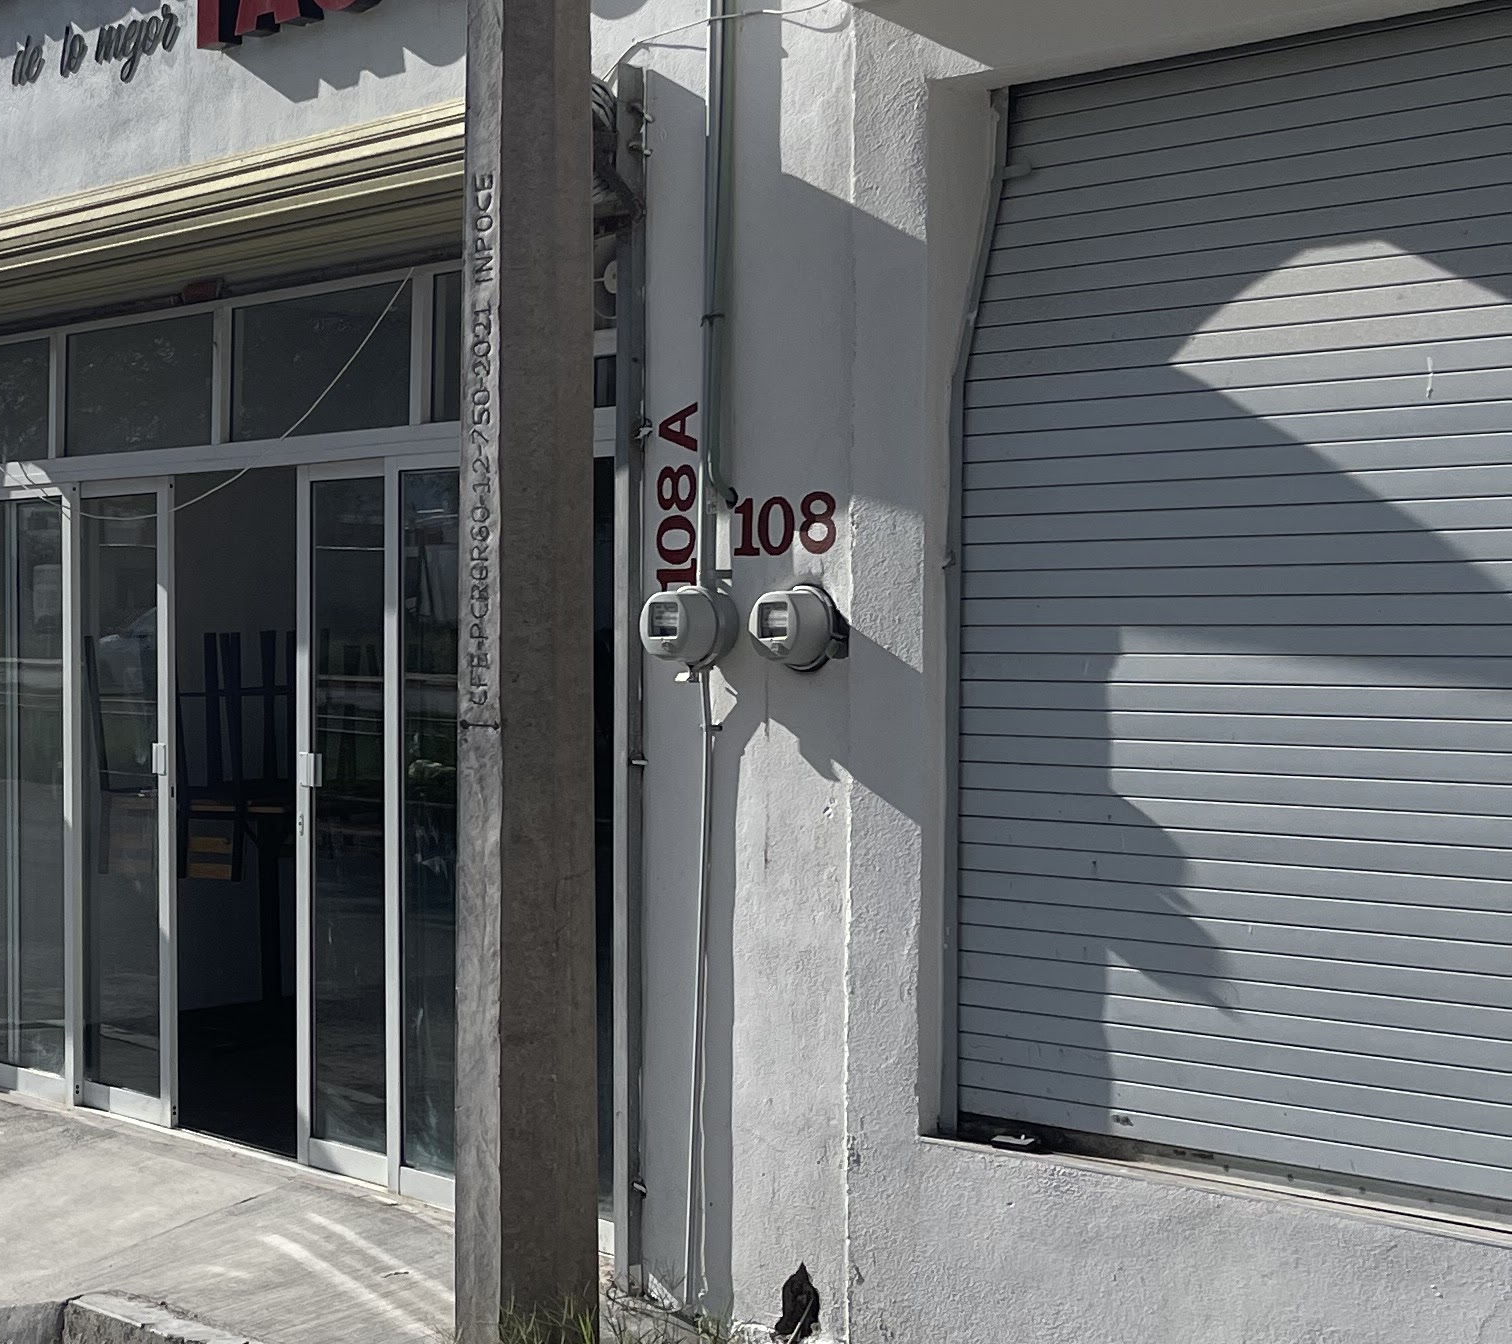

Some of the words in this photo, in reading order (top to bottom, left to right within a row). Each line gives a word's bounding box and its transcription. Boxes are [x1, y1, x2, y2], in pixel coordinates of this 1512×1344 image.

[11, 34, 46, 87] de
[60, 24, 88, 78] lo
[94, 3, 180, 84] mejor
[473, 173, 494, 284] INPOCE
[733, 491, 837, 557] 108
